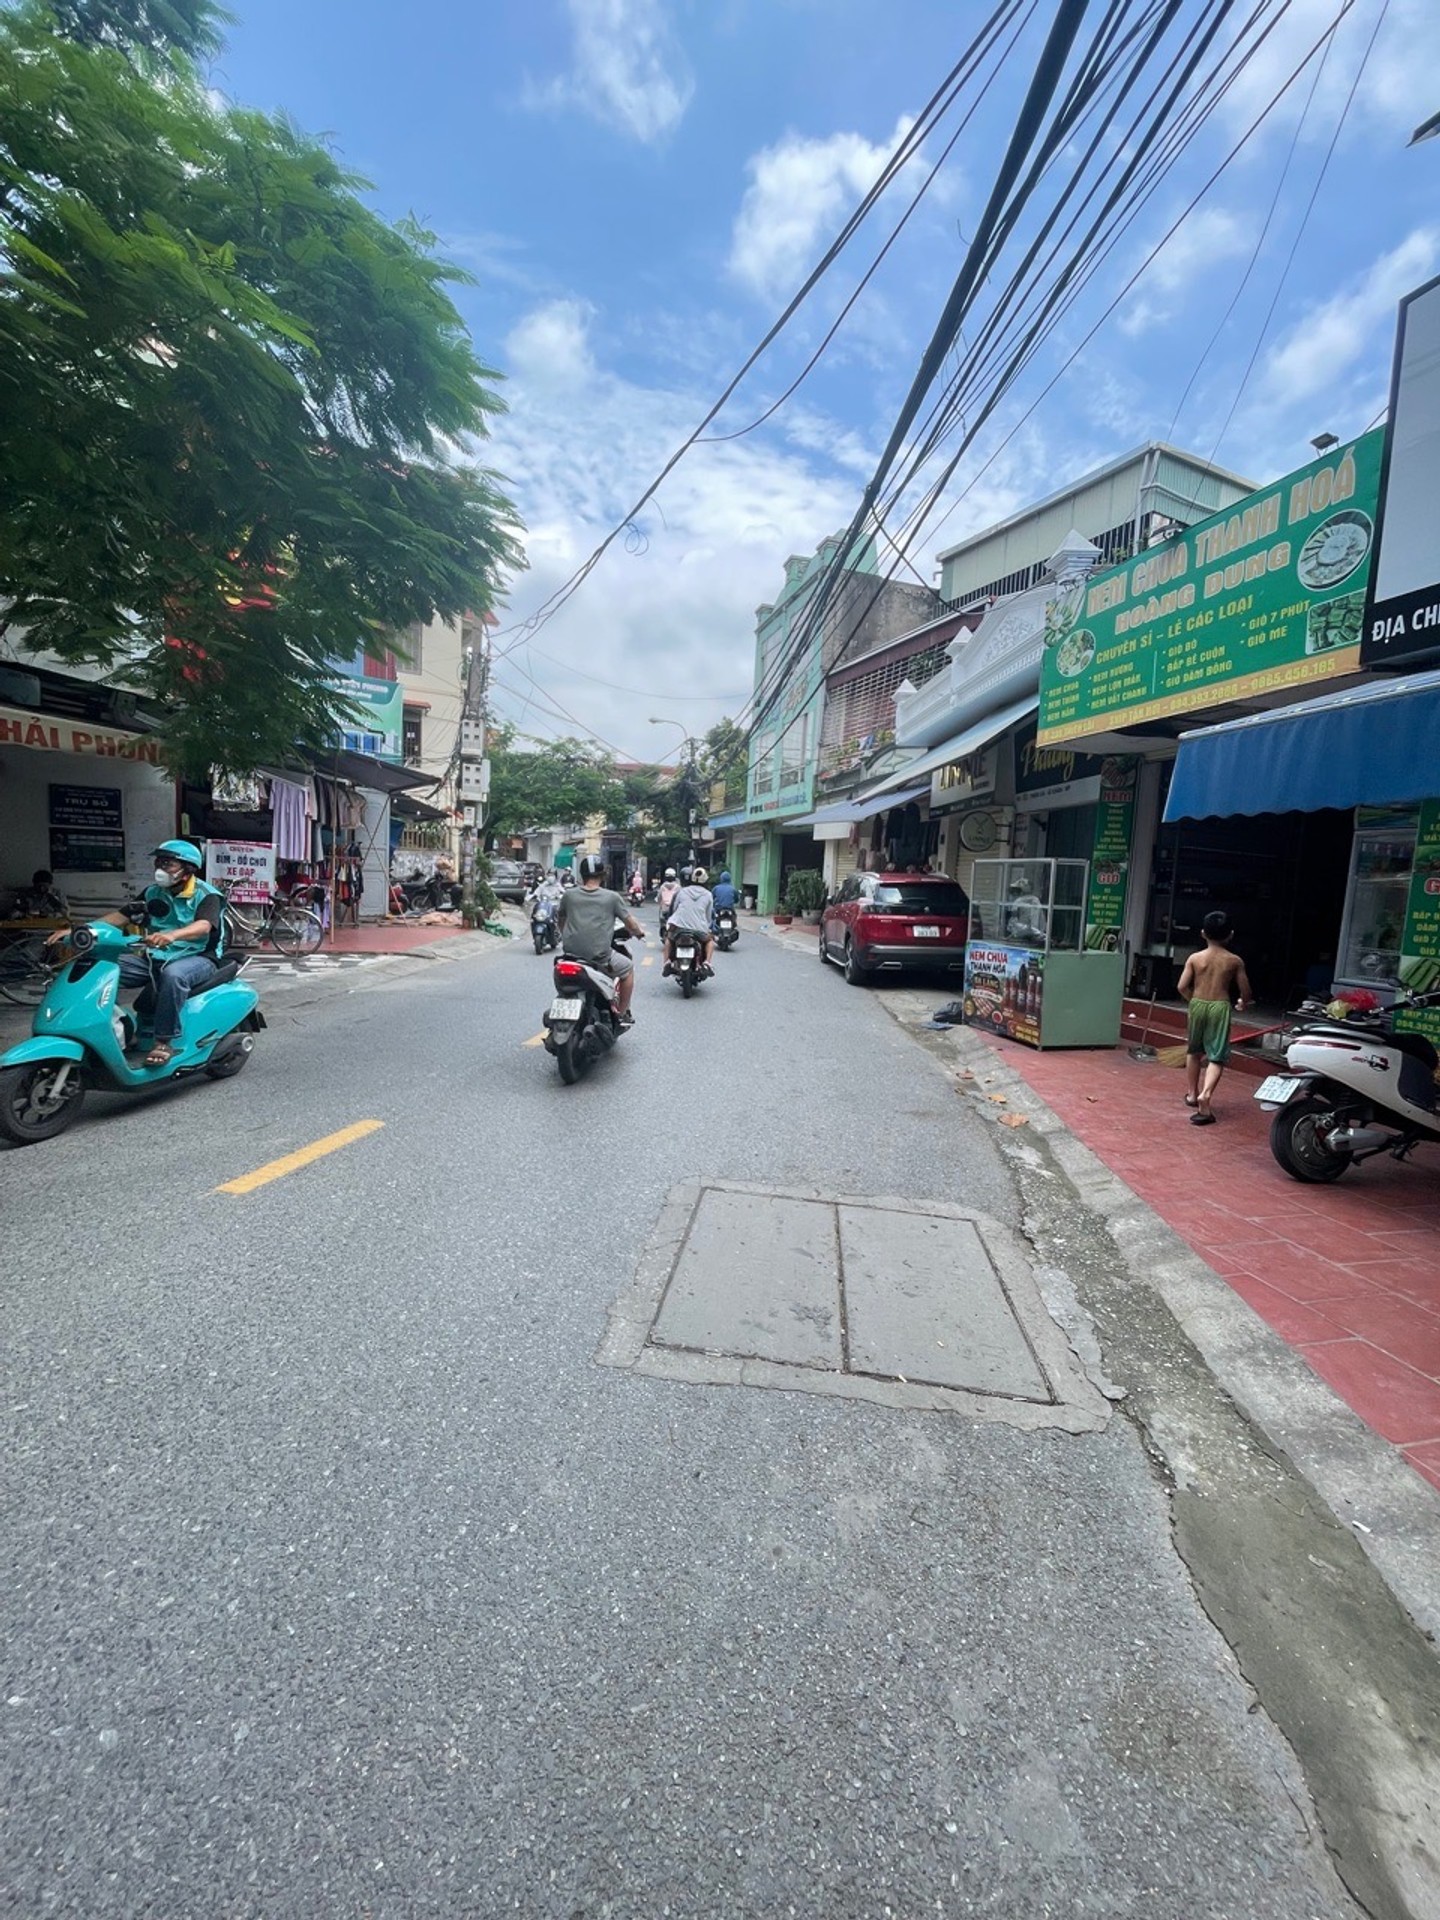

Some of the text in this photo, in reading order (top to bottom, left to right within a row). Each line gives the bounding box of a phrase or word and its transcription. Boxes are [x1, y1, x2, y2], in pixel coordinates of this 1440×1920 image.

[1086, 446, 1356, 618] NEM CHUA THANH HOÁ
[1115, 542, 1292, 635] HOÀNG DUNG
[1270, 611, 1279, 623] 7
[1280, 600, 1311, 620] PHÚT
[1096, 636, 1137, 665] CHUYÊN
[1186, 609, 1214, 632] CÁC
[1218, 595, 1254, 619] LOẠI
[1371, 615, 1405, 644] ĐỊA
[0, 716, 60, 749] HẢI
[227, 867, 238, 875] XE
[969, 950, 1008, 964] NEM CHUA
[970, 962, 991, 972] THANH
